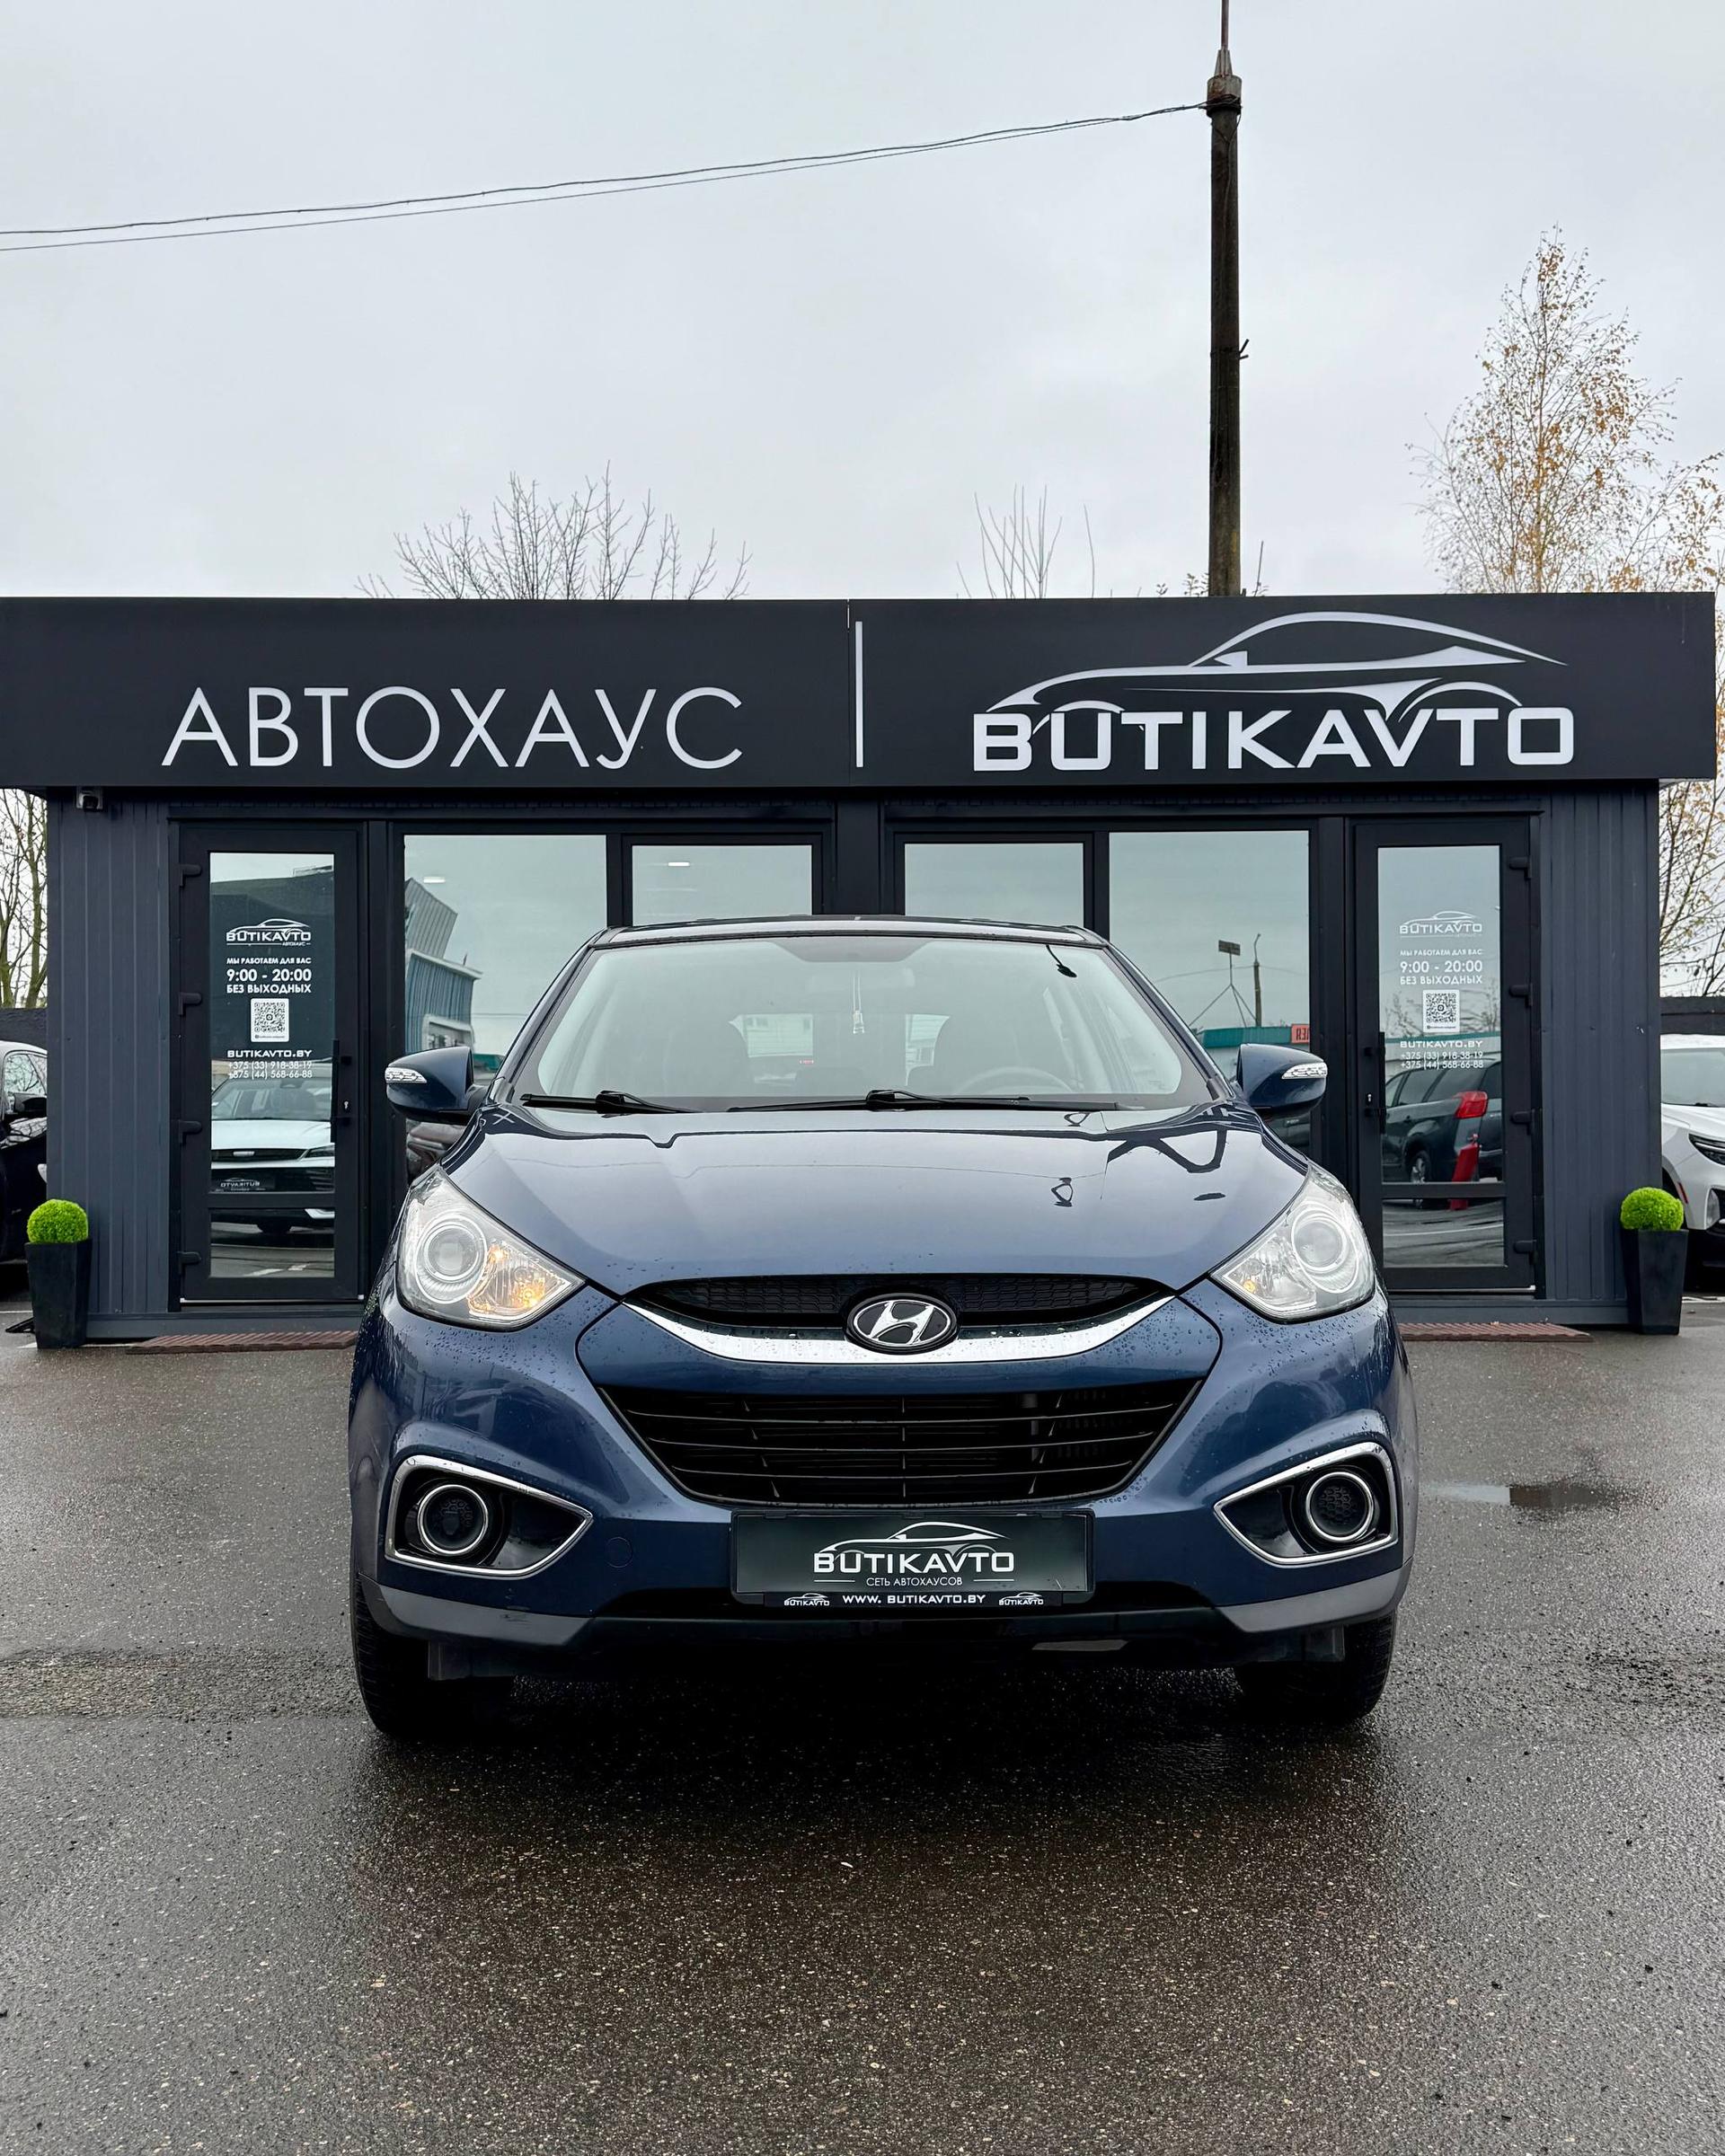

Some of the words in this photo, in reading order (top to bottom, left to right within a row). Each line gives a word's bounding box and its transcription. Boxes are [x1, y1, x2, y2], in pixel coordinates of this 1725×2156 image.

[162, 685, 743, 771] АВТОХАУС
[973, 706, 1575, 773] BUTIKAVTO
[1399, 923, 1482, 934] BUTIKAVTO
[226, 932, 312, 941] BUTIKAVTO
[1400, 960, 1429, 973] 9:00
[1444, 960, 1482, 973] 20:00
[226, 968, 258, 982] 9:00
[271, 968, 312, 981] 20:00
[1400, 976, 1417, 985] БЕЗ
[1420, 976, 1482, 985] ВЫХОДНЫХ
[226, 985, 244, 994] БЕЗ
[247, 984, 312, 994] ВЫХОДНЫХ
[1400, 1040, 1483, 1048] BUTIKAVTO.BY
[227, 1050, 312, 1058] BUTIKAVTO.BY
[1423, 1051, 1439, 1061] (33)
[1442, 1051, 1483, 1059] 918-38-19
[229, 1061, 249, 1069] +375
[252, 1061, 268, 1071] (33)
[270, 1061, 312, 1069] 918-38-19
[1402, 1061, 1421, 1069] +375
[1423, 1060, 1439, 1070] (44)
[252, 1070, 268, 1080] (44)
[813, 1551, 1014, 1574] BUTIKAVTO
[866, 1577, 890, 1586] СЕТЬ
[893, 1577, 963, 1586] АВТОХАУСОВ
[843, 1595, 881, 1604] WWW.
[887, 1595, 986, 1604] BUTIKAVTO.BY
